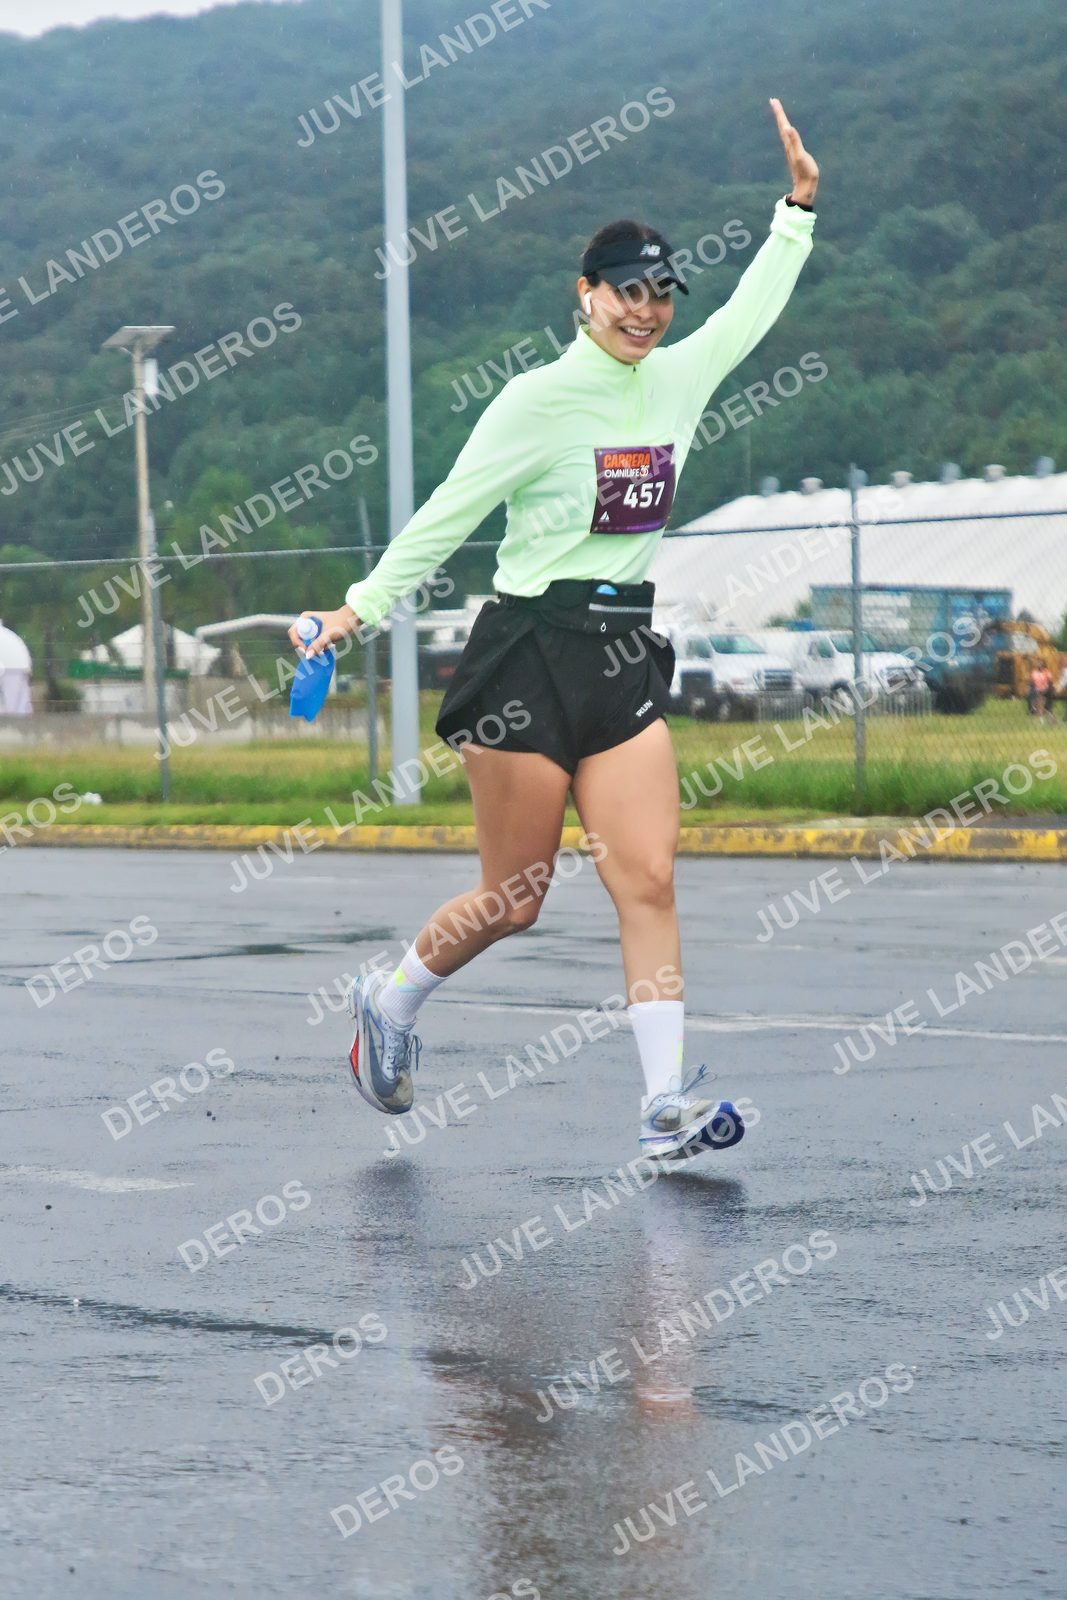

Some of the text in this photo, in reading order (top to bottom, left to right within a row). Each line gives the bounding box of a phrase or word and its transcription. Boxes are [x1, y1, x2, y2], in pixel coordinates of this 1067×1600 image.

[603, 452, 651, 469] CARRERA
[623, 481, 665, 508] 457
[635, 699, 653, 717] RUN
